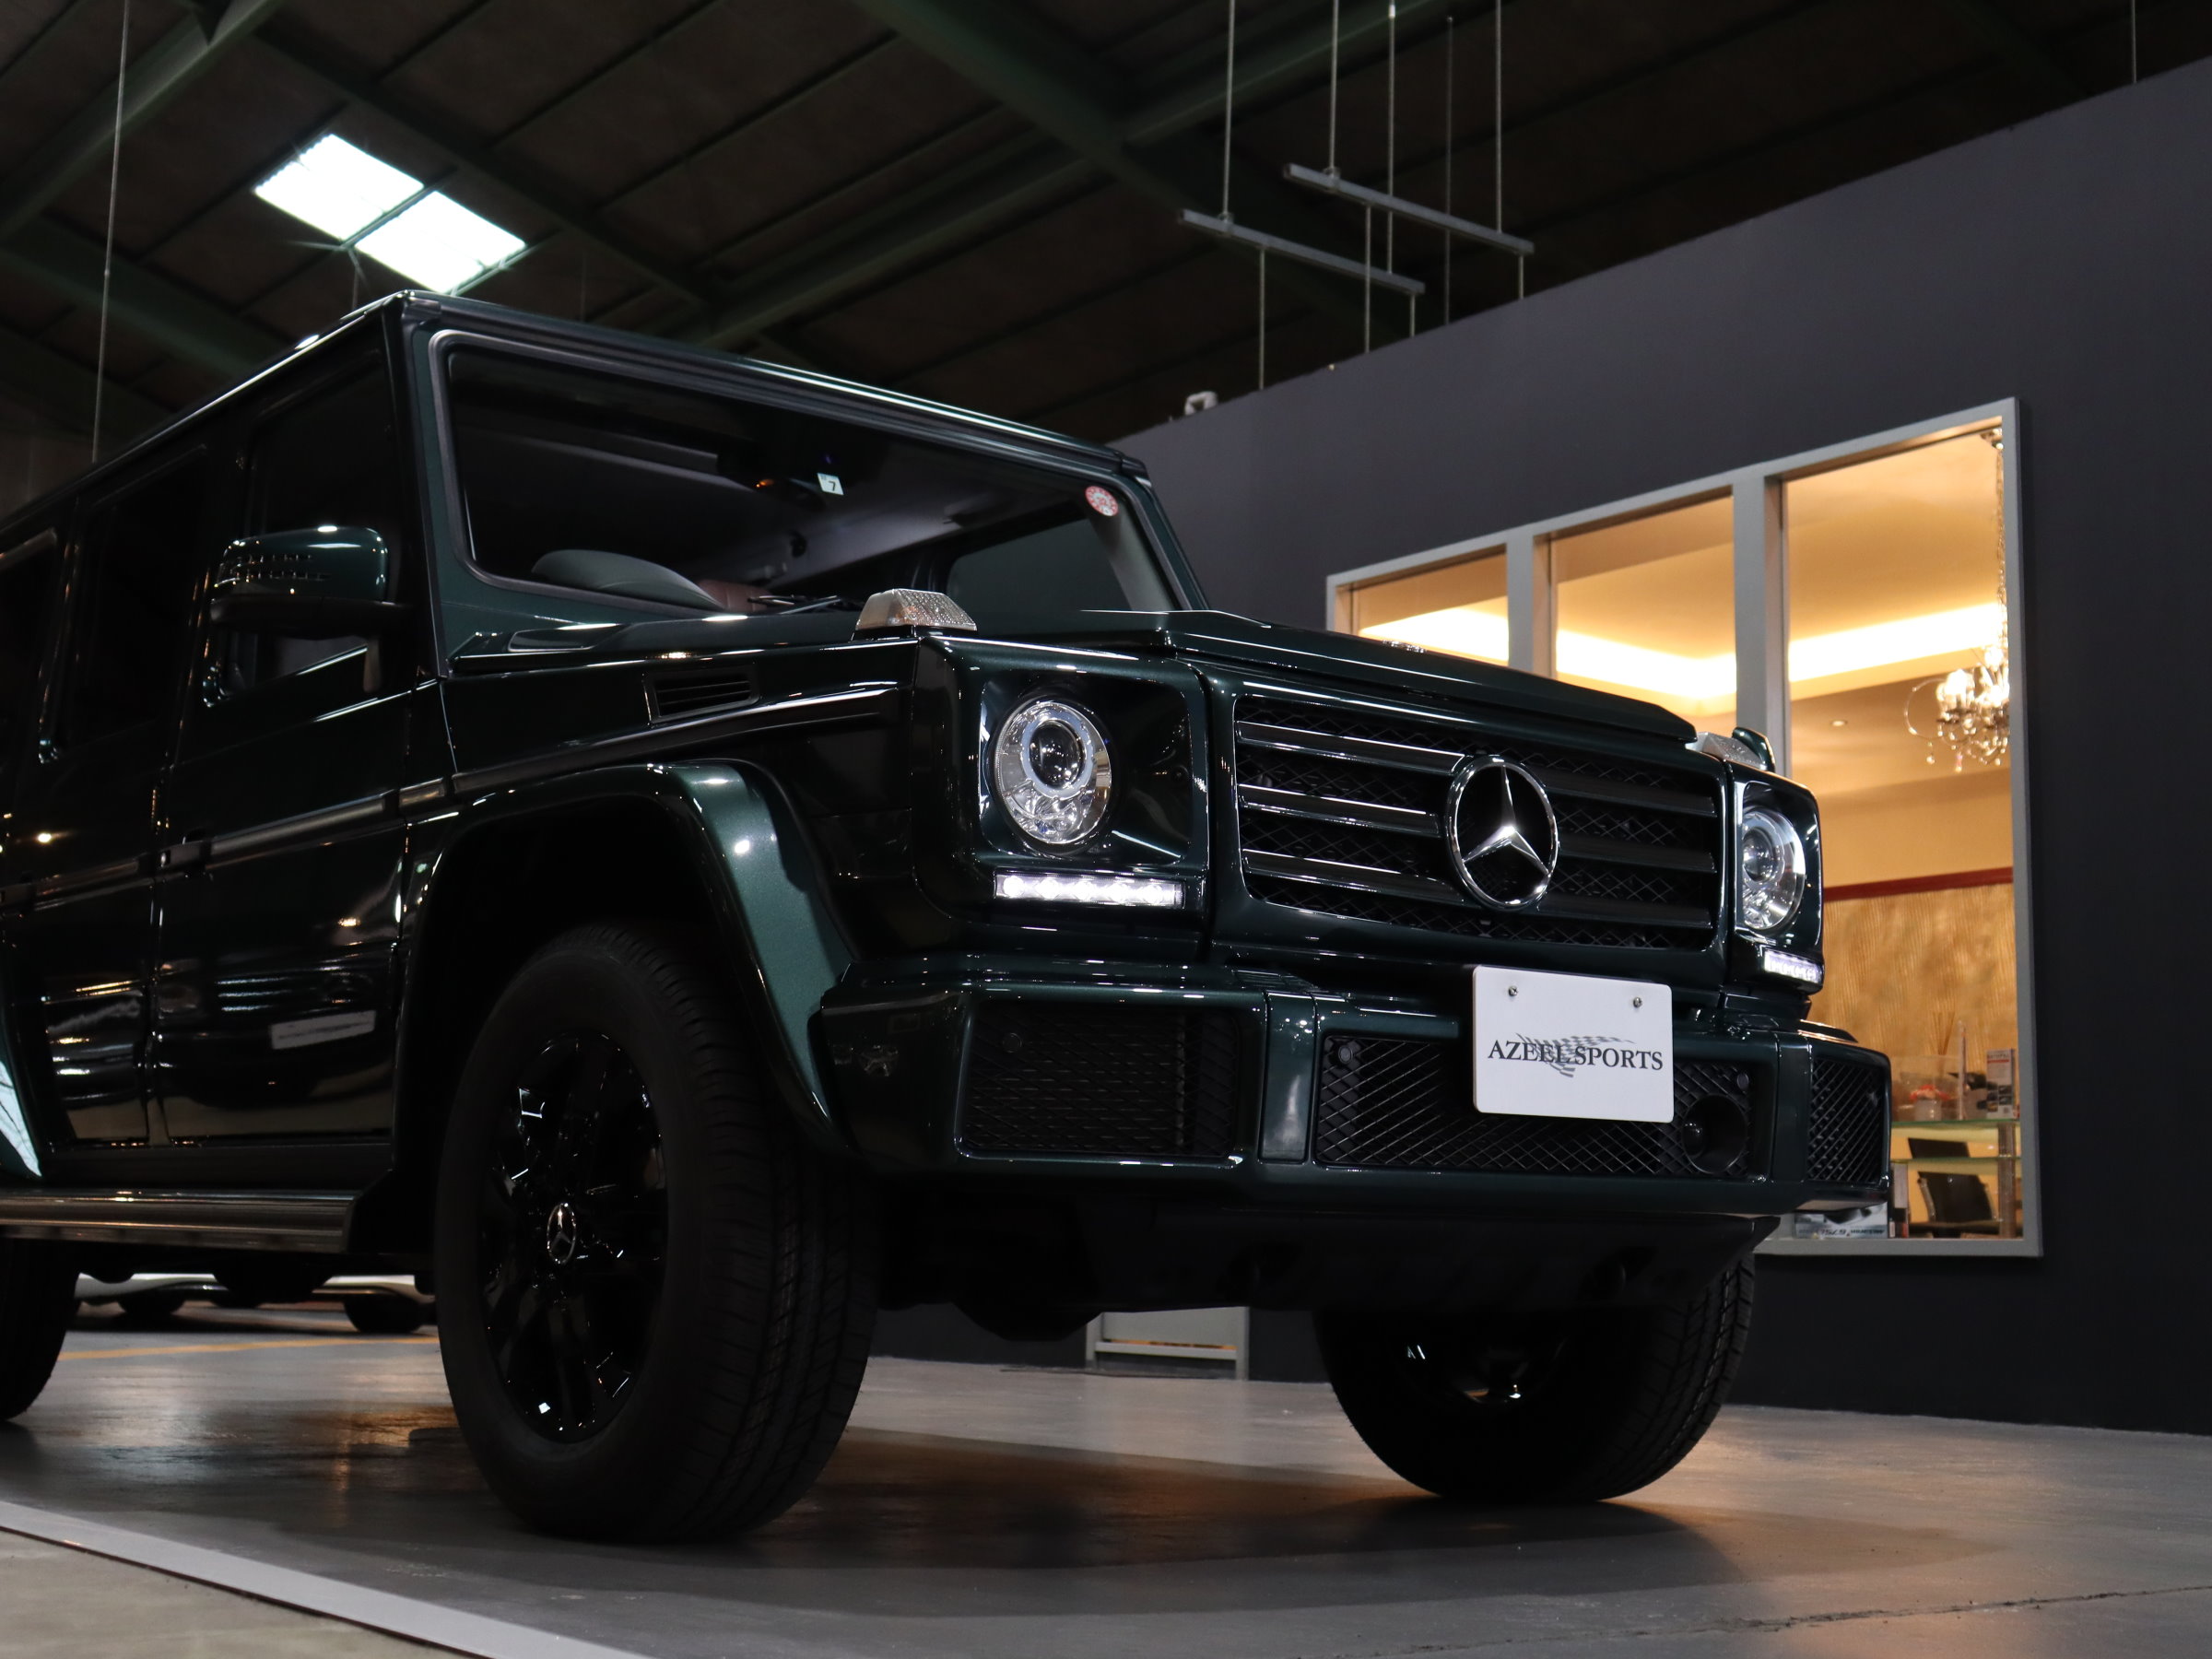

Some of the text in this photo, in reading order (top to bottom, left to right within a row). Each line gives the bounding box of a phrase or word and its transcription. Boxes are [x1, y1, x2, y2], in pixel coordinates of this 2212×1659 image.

[828, 480, 837, 491] 7
[1488, 1039, 1664, 1071] AZEEL SPORTS
